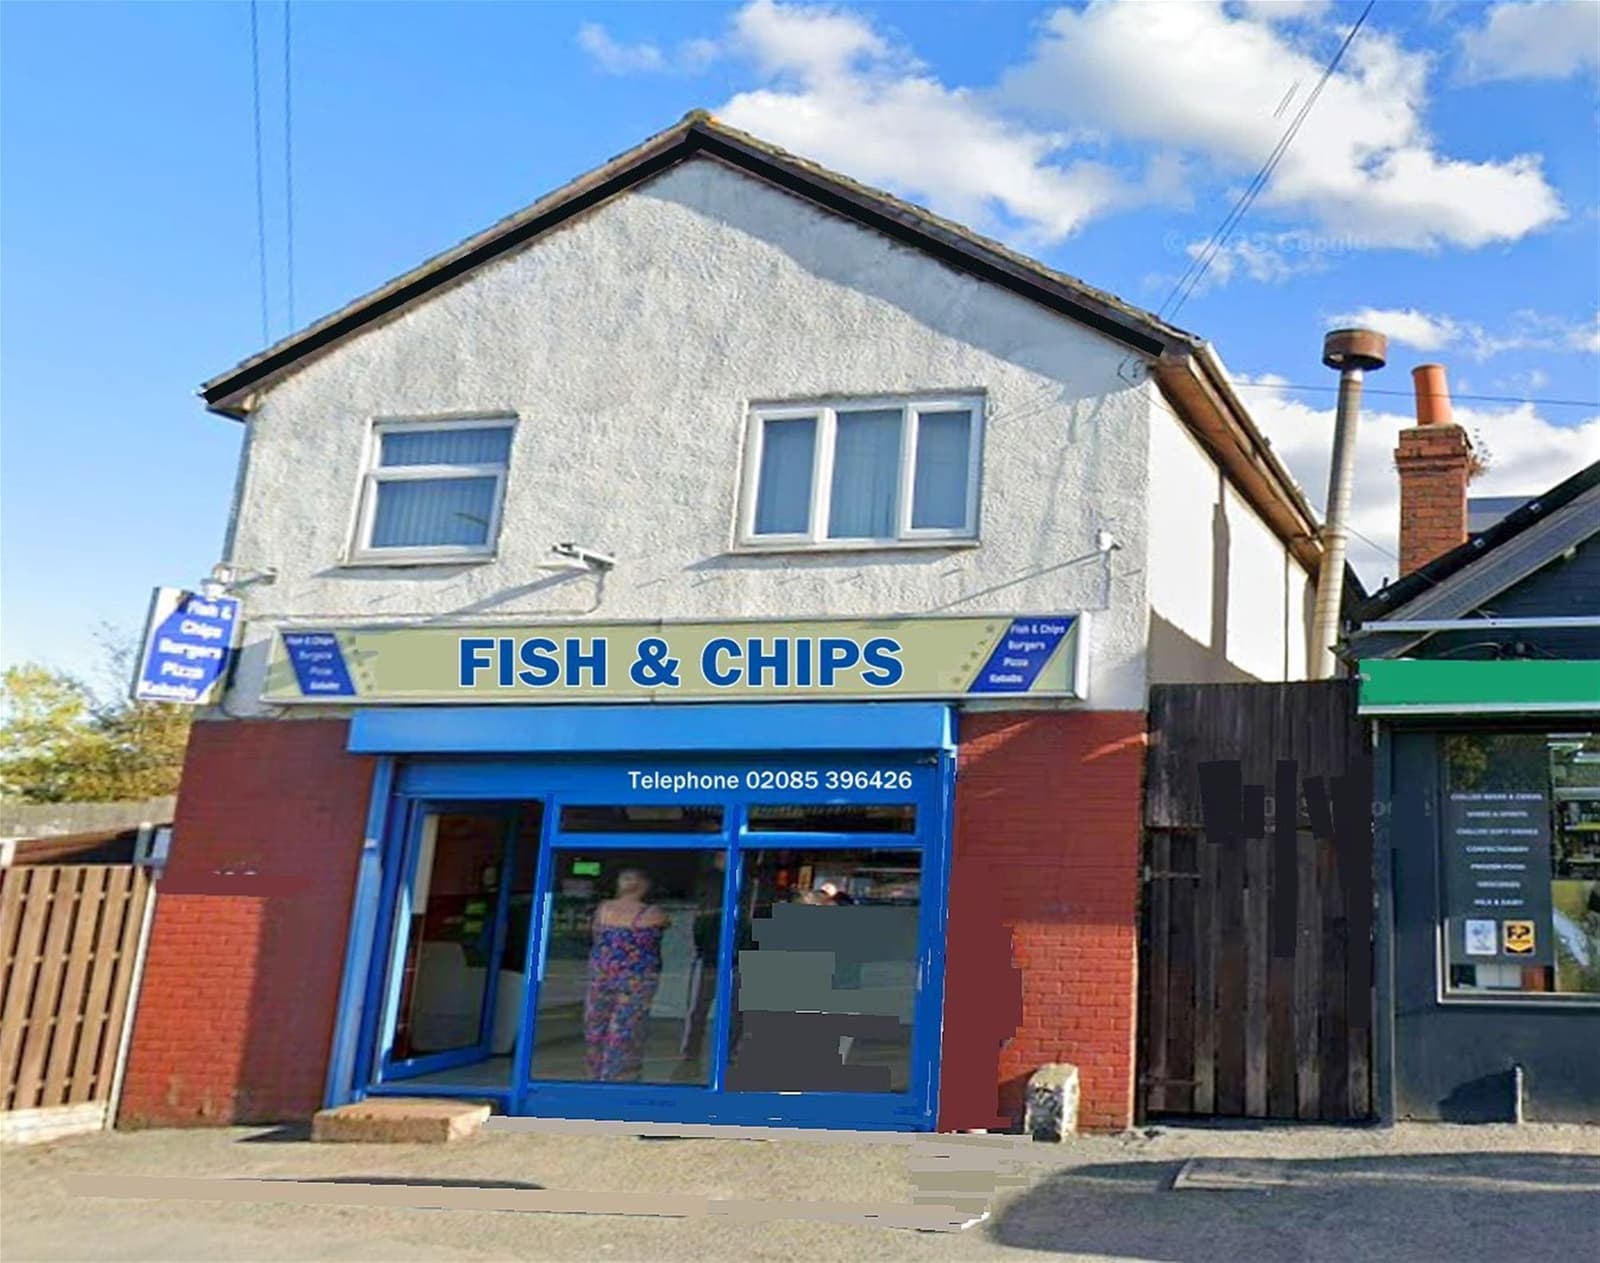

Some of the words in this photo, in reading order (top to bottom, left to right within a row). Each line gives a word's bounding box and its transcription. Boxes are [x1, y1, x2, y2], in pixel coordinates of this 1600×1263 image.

[180, 620, 223, 639] Chips
[1010, 623, 1030, 635] Fish
[1031, 623, 1039, 635] &
[1040, 623, 1066, 637] Chips
[158, 638, 223, 660] Burgers
[1007, 640, 1046, 653] Burgers
[459, 637, 608, 688] FISH
[630, 637, 681, 688] &
[701, 637, 904, 688] CHIPS
[1003, 656, 1029, 667] Pizza
[628, 770, 740, 793] Telephone
[745, 770, 819, 790] 02085
[825, 770, 913, 790] 396426
